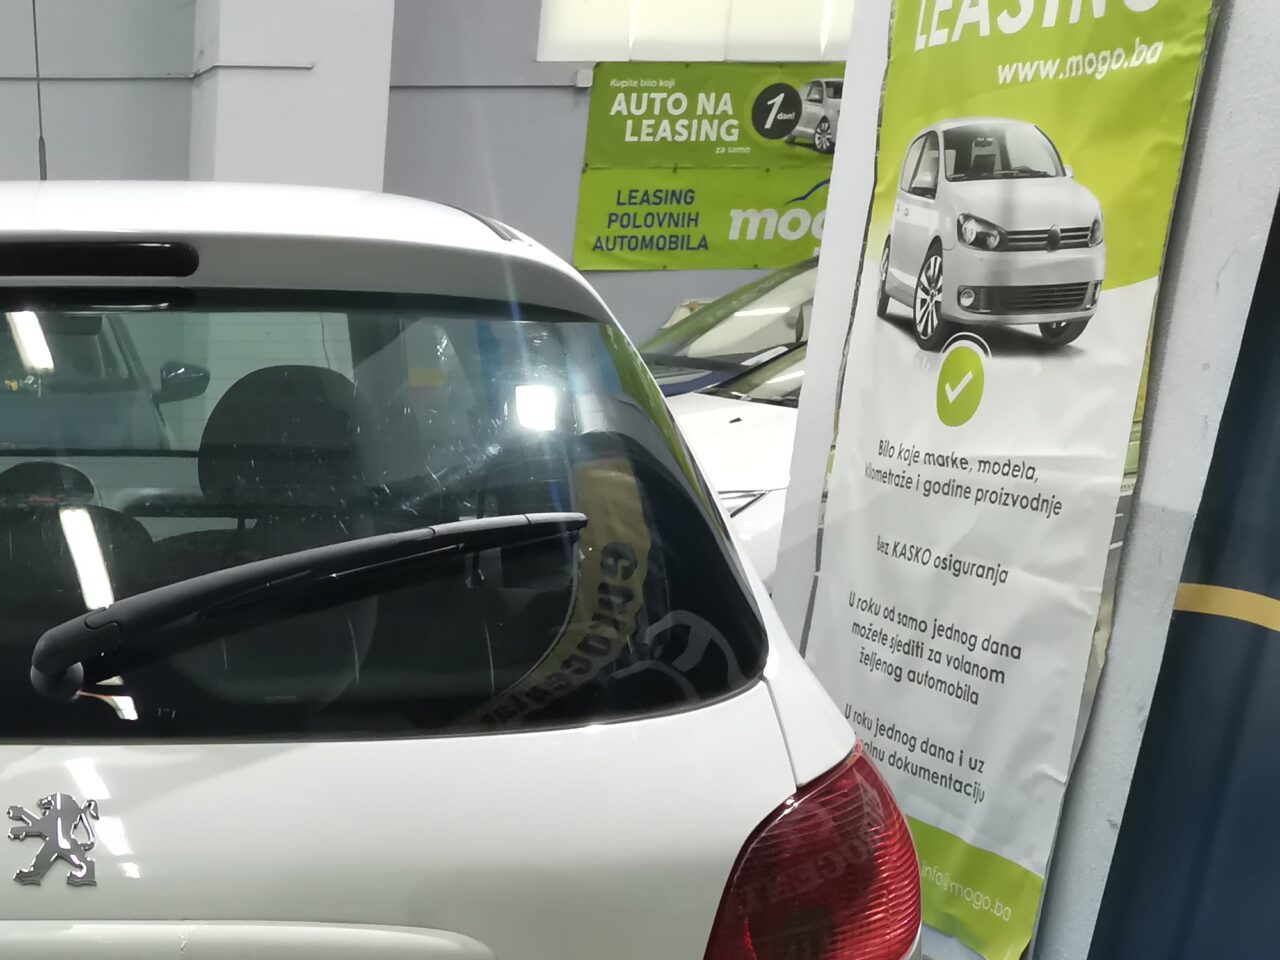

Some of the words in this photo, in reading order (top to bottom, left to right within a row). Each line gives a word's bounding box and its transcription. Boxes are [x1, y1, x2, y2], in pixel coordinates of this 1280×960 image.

[915, 0, 1160, 50] LEAS
[997, 37, 1164, 84] www.mogo.ba
[610, 92, 688, 115] AUTO
[697, 92, 733, 115] NA
[659, 79, 676, 89] koji
[625, 119, 739, 142] LEASING
[764, 92, 785, 129] 1
[777, 111, 795, 121] dan!
[616, 189, 695, 206] LEASING
[592, 234, 709, 251] AUTOMOBILA
[607, 212, 699, 229] POLOVNIH
[878, 440, 895, 459] Bilo
[897, 443, 920, 467] koje
[923, 451, 973, 473] marke,
[977, 459, 1039, 483] modela,
[916, 474, 920, 491] i
[923, 479, 971, 499] godine
[974, 487, 1063, 519] proizvodnje
[891, 541, 932, 566] KASKO
[933, 554, 1009, 586] osiguranja
[848, 591, 856, 607] U
[856, 598, 881, 616] roku
[883, 606, 896, 622] od
[897, 612, 928, 633] samo
[931, 618, 978, 652] jednog
[981, 635, 1021, 660] dana
[852, 622, 888, 646] možete
[889, 634, 924, 659] sjediti
[927, 648, 942, 664] za
[946, 654, 1005, 684] volanom
[859, 647, 903, 683] željenog
[907, 668, 979, 706] automobila
[844, 703, 852, 719] U
[853, 709, 873, 731] roku
[874, 718, 917, 753] jednog
[920, 737, 954, 764] dana
[959, 750, 964, 767] i
[968, 757, 985, 774] uz
[888, 751, 986, 804] dokumentaciju
